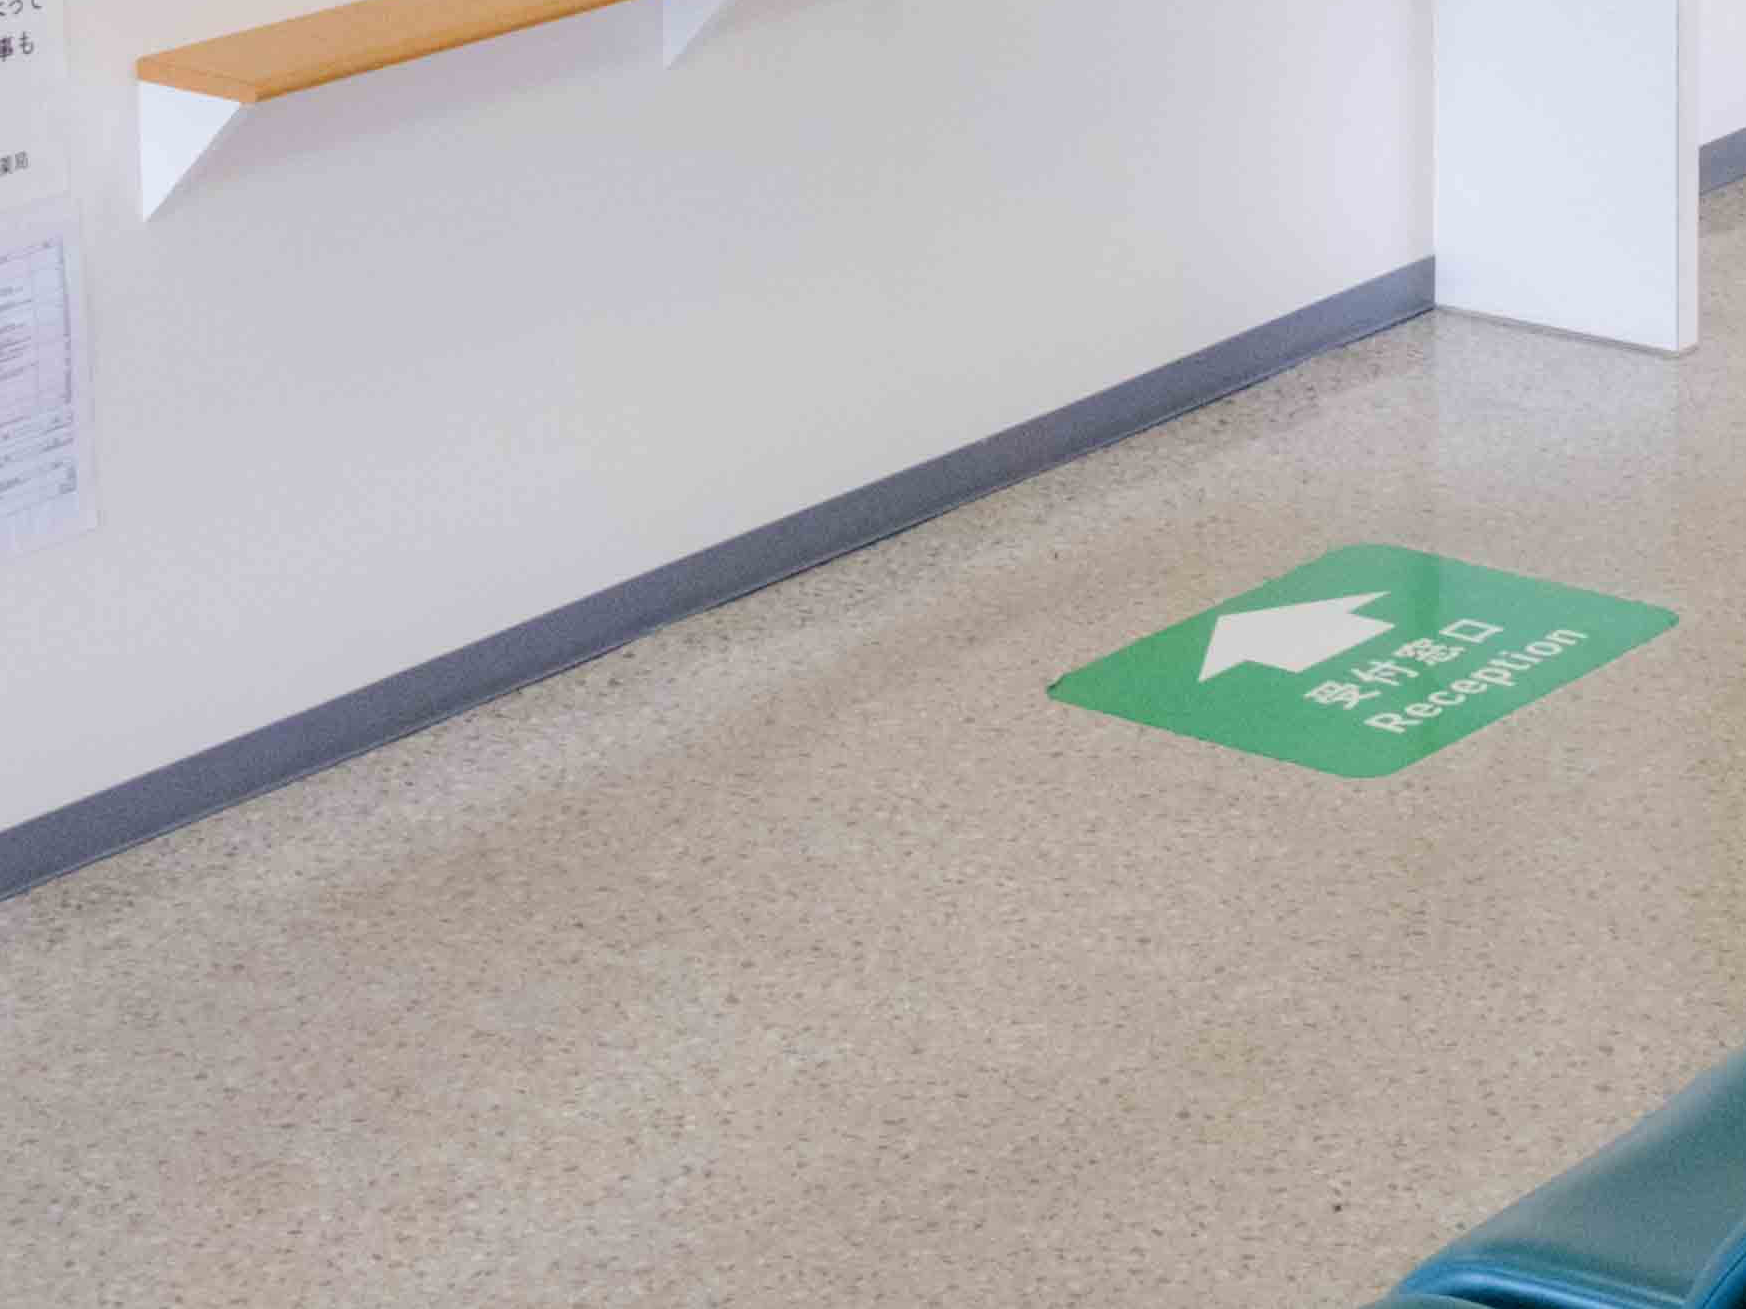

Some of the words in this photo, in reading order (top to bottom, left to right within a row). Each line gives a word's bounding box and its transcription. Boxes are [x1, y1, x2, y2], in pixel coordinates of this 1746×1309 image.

[1304, 617, 1505, 711] 受付窓口
[1363, 627, 1590, 733] Reception
